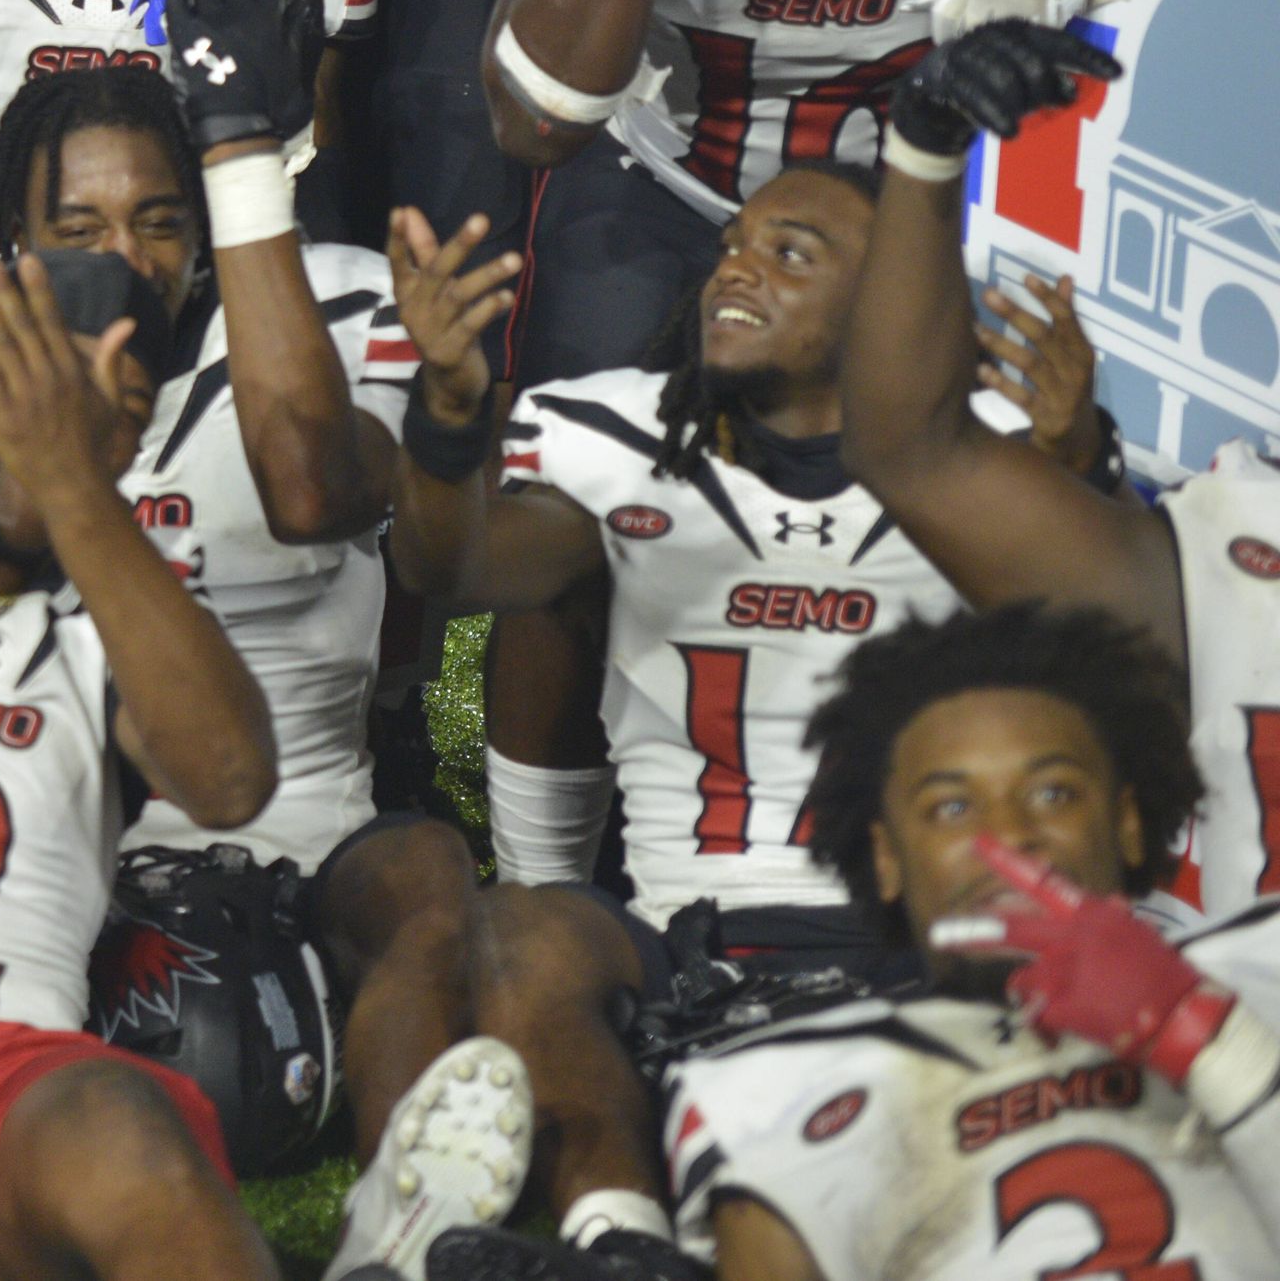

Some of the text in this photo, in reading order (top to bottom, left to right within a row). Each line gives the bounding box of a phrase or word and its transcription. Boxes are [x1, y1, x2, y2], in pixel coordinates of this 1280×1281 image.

[726, 583, 876, 634] SEMO
[665, 643, 815, 855] 1
[957, 1059, 1143, 1155] SEMO
